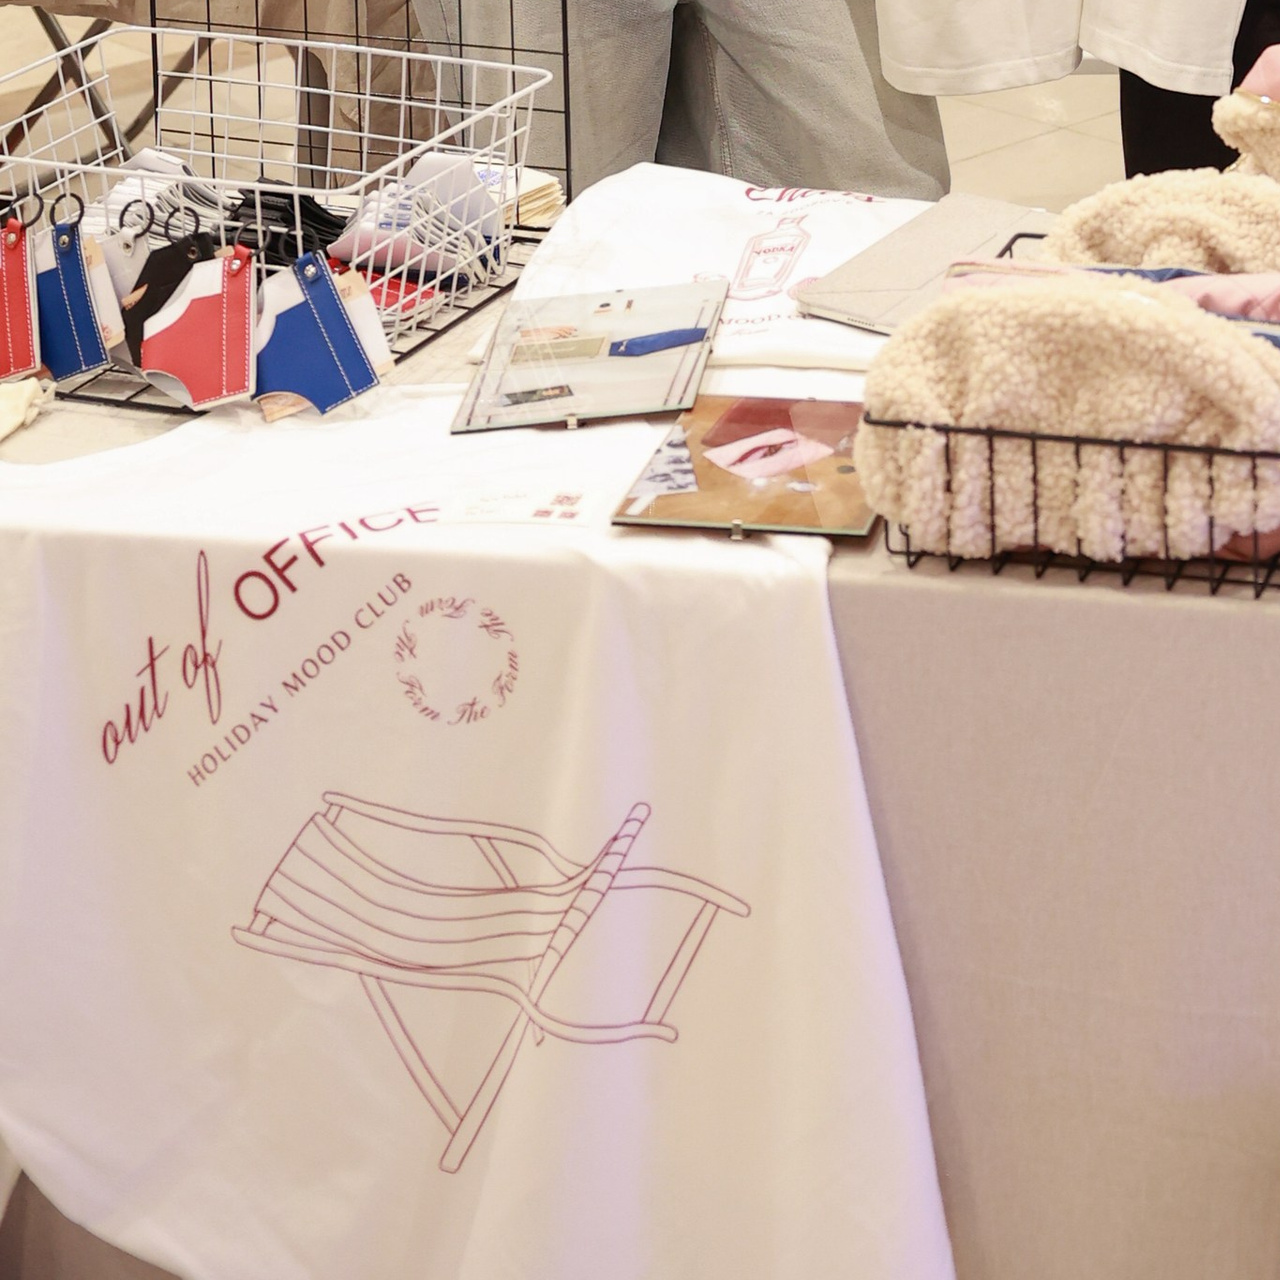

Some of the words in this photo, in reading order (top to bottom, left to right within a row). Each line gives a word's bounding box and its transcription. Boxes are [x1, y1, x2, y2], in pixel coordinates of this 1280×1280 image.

[753, 245, 795, 256] VODKA
[102, 636, 170, 765] out
[182, 549, 222, 725] of
[233, 500, 440, 621] OFFICE
[187, 696, 280, 787] HOLIDAY
[282, 630, 353, 698] MOOD
[354, 572, 413, 630] CLUB
